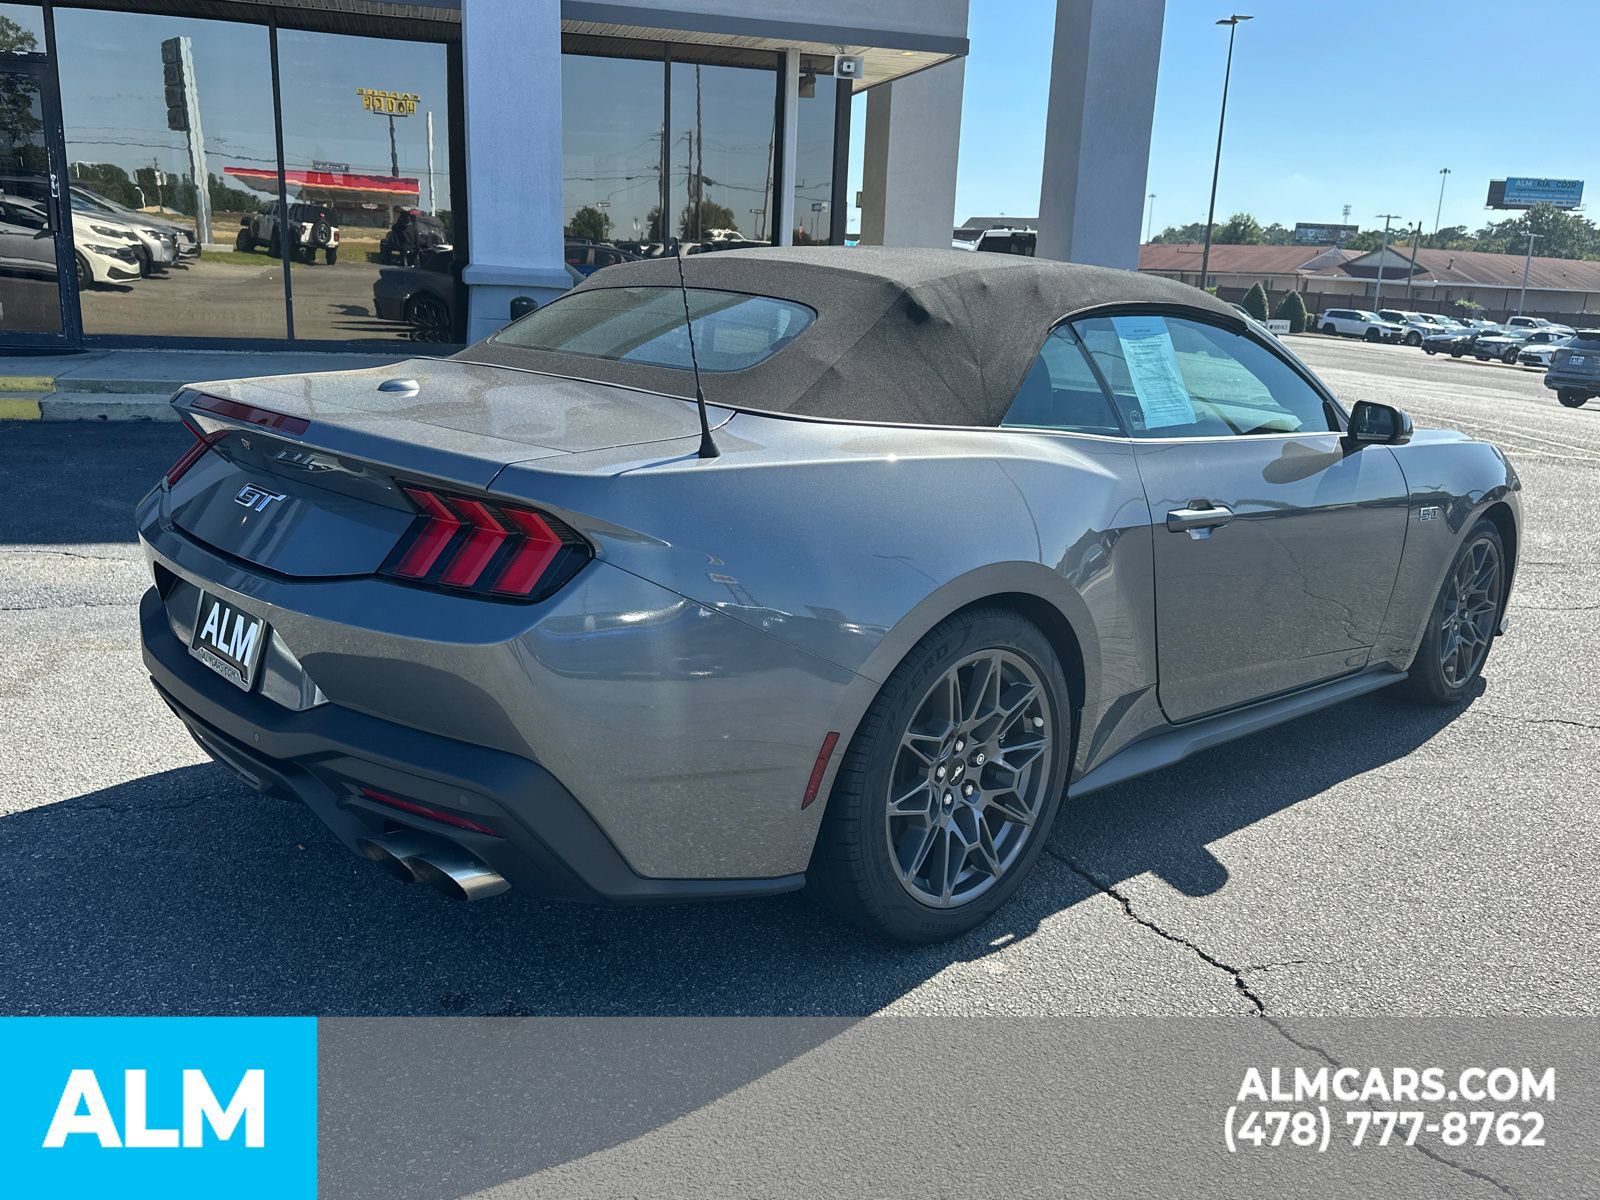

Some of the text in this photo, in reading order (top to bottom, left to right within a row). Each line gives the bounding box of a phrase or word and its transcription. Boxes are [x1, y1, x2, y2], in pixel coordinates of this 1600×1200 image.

[235, 483, 287, 512] GT
[200, 601, 258, 667] ALM
[899, 642, 948, 711] ZERO
